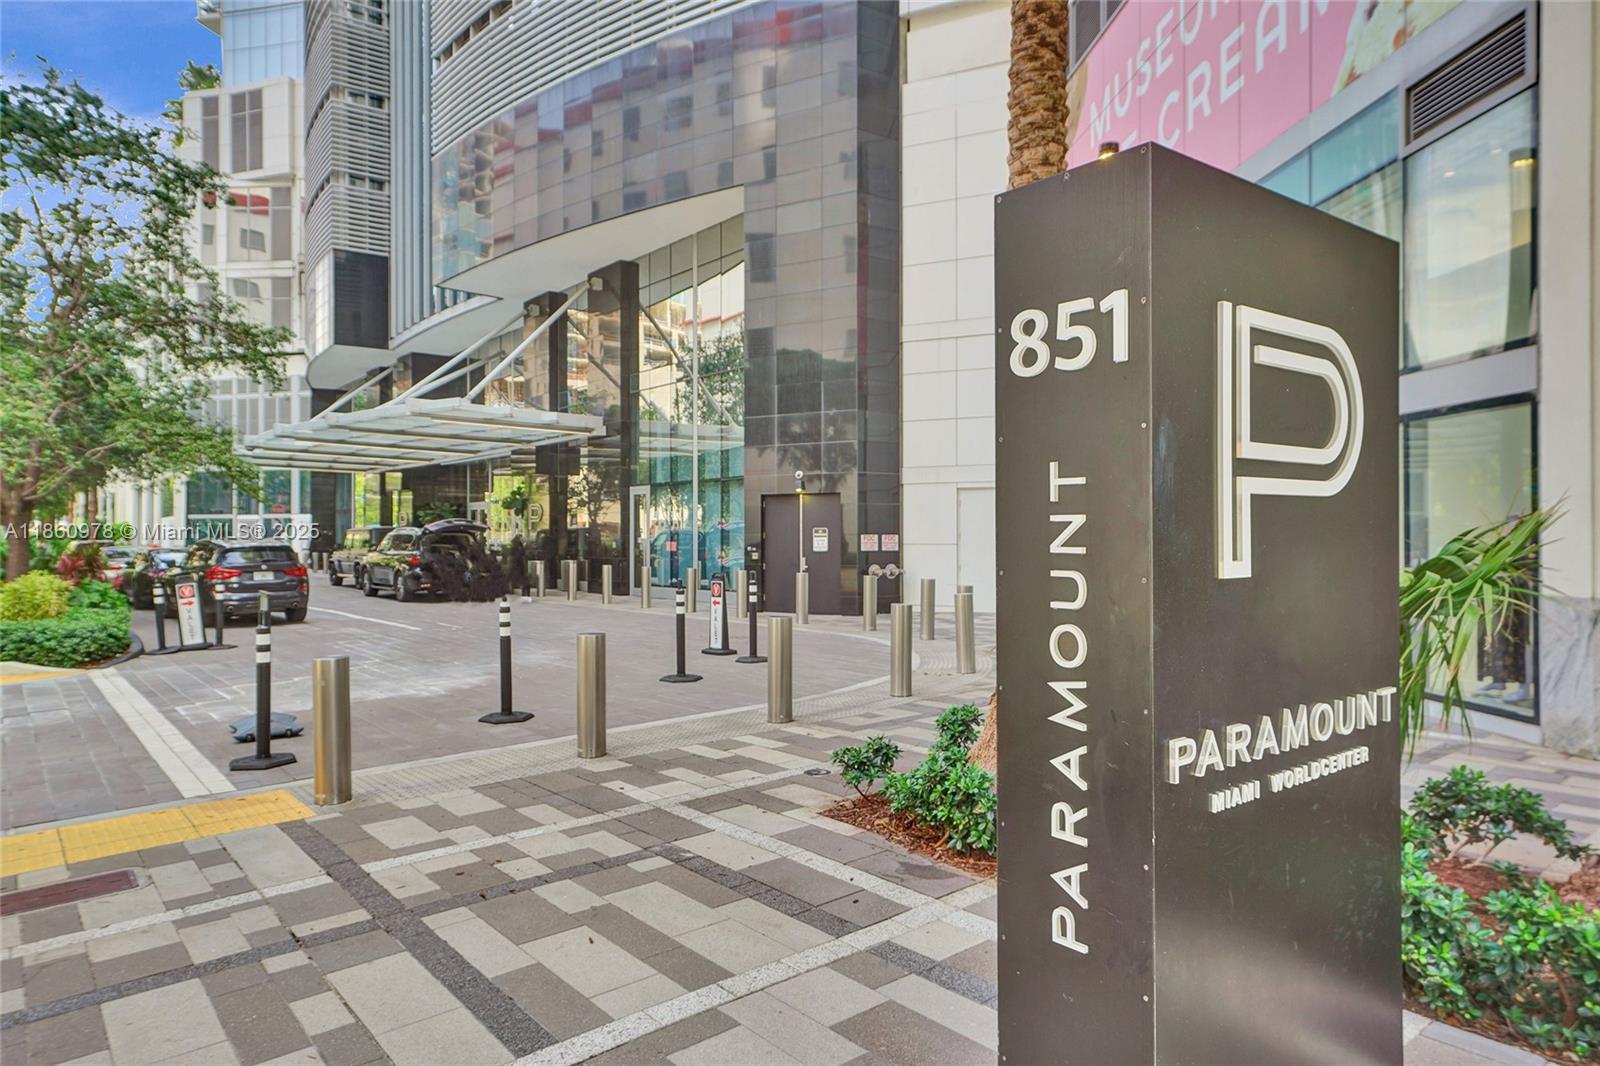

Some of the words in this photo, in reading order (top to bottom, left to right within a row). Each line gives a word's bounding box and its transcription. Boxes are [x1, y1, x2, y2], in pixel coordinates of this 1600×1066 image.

[1009, 288, 1129, 378] 851
[1217, 300, 1364, 579] P
[1047, 461, 1089, 955] PARAMOUNT
[1167, 686, 1397, 785] PARAMOUNT
[1208, 780, 1261, 814] MIAMI
[1268, 746, 1369, 793] WORLDCENTER
